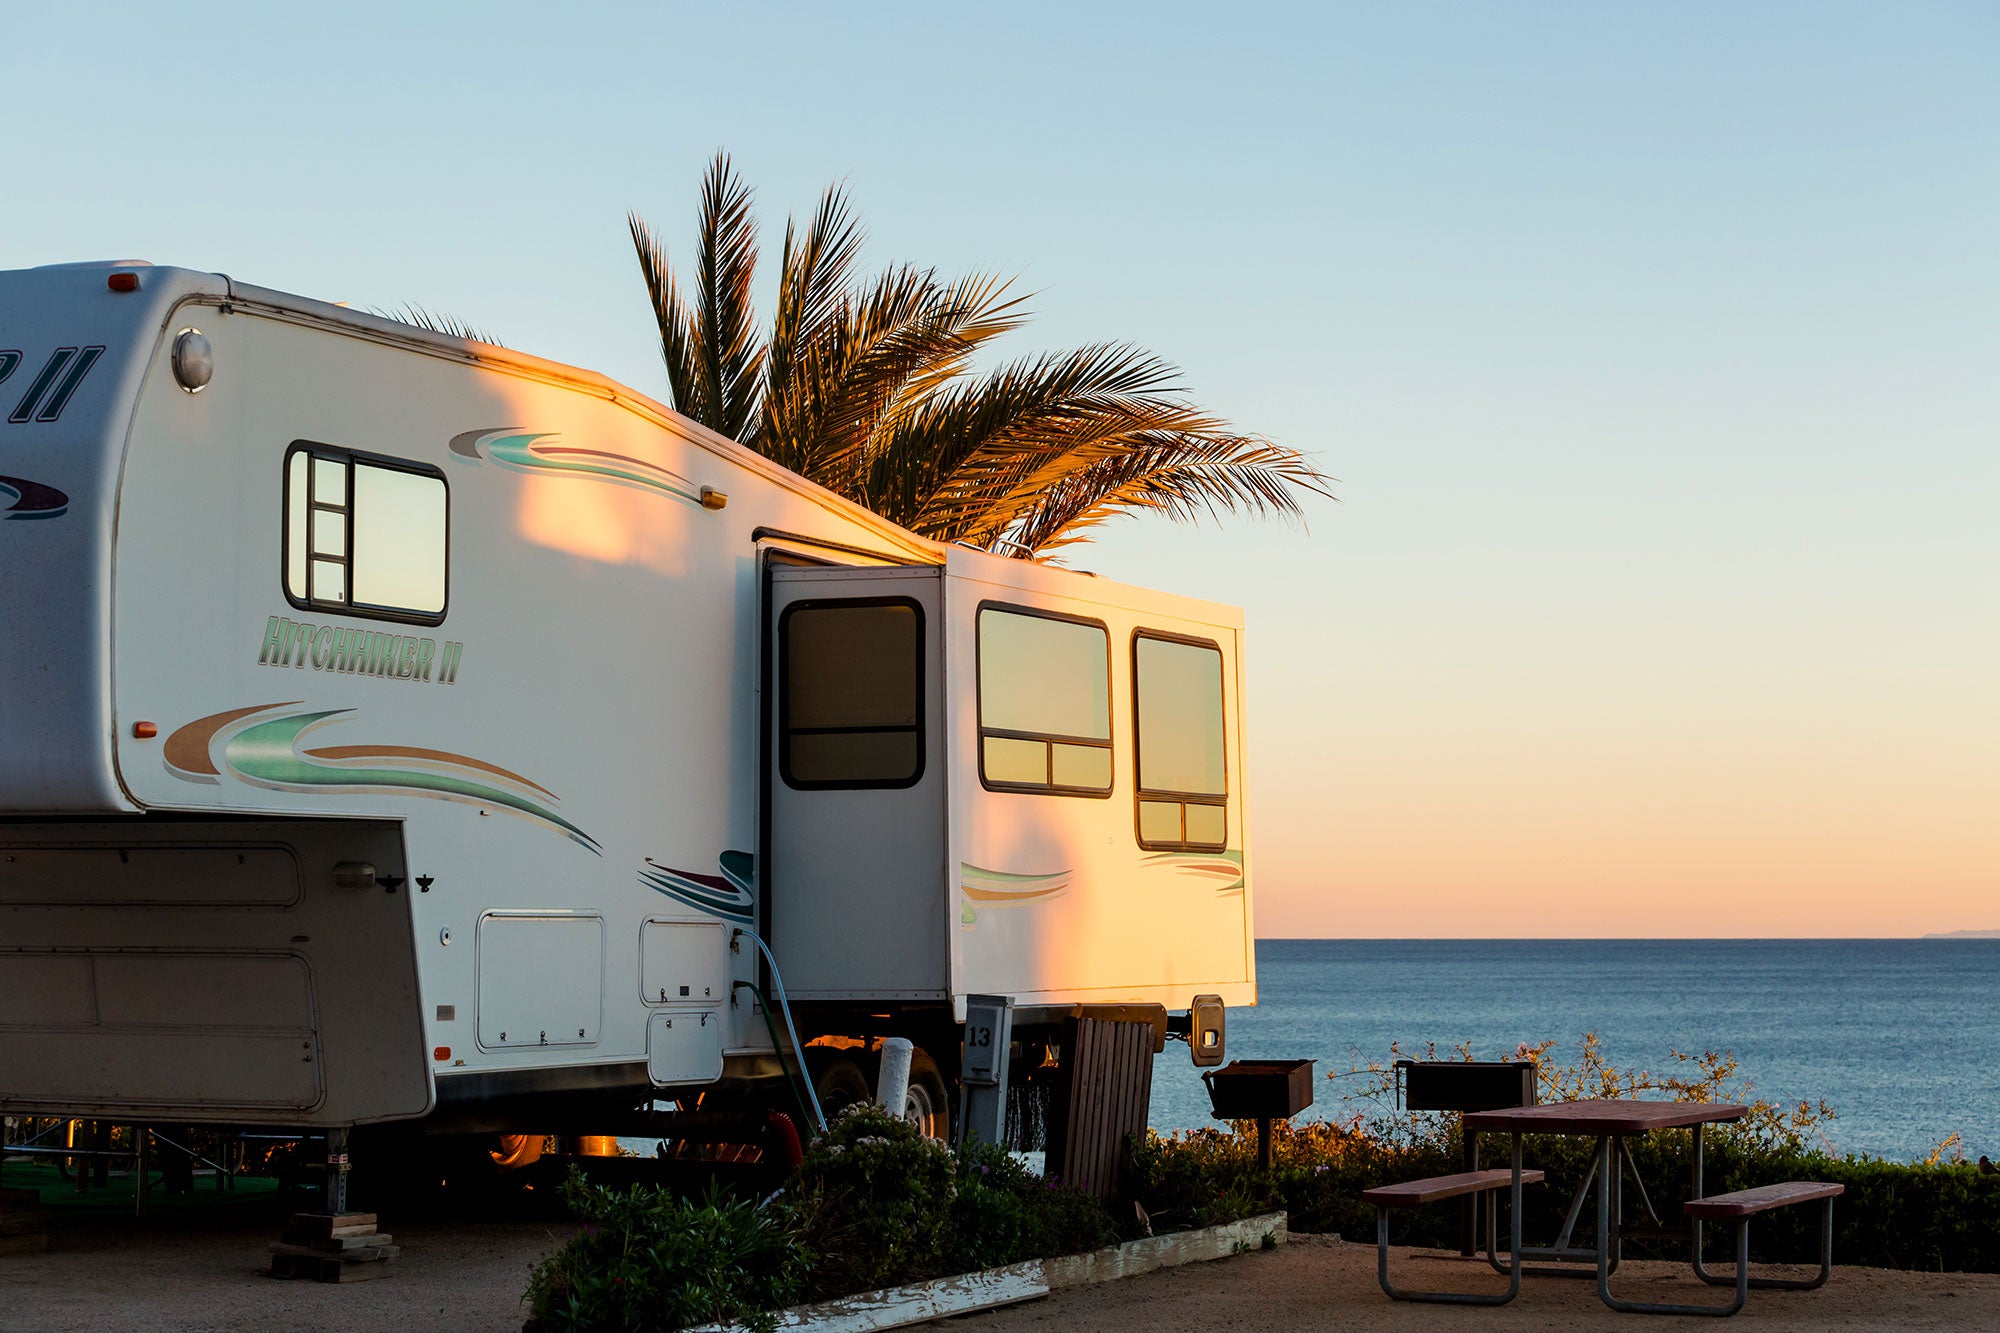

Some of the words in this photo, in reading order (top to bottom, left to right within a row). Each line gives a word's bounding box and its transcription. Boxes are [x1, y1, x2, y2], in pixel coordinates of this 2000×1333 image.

[257, 616, 437, 683] HITCHHIKER
[438, 641, 463, 685] II
[969, 1026, 991, 1047] 13
